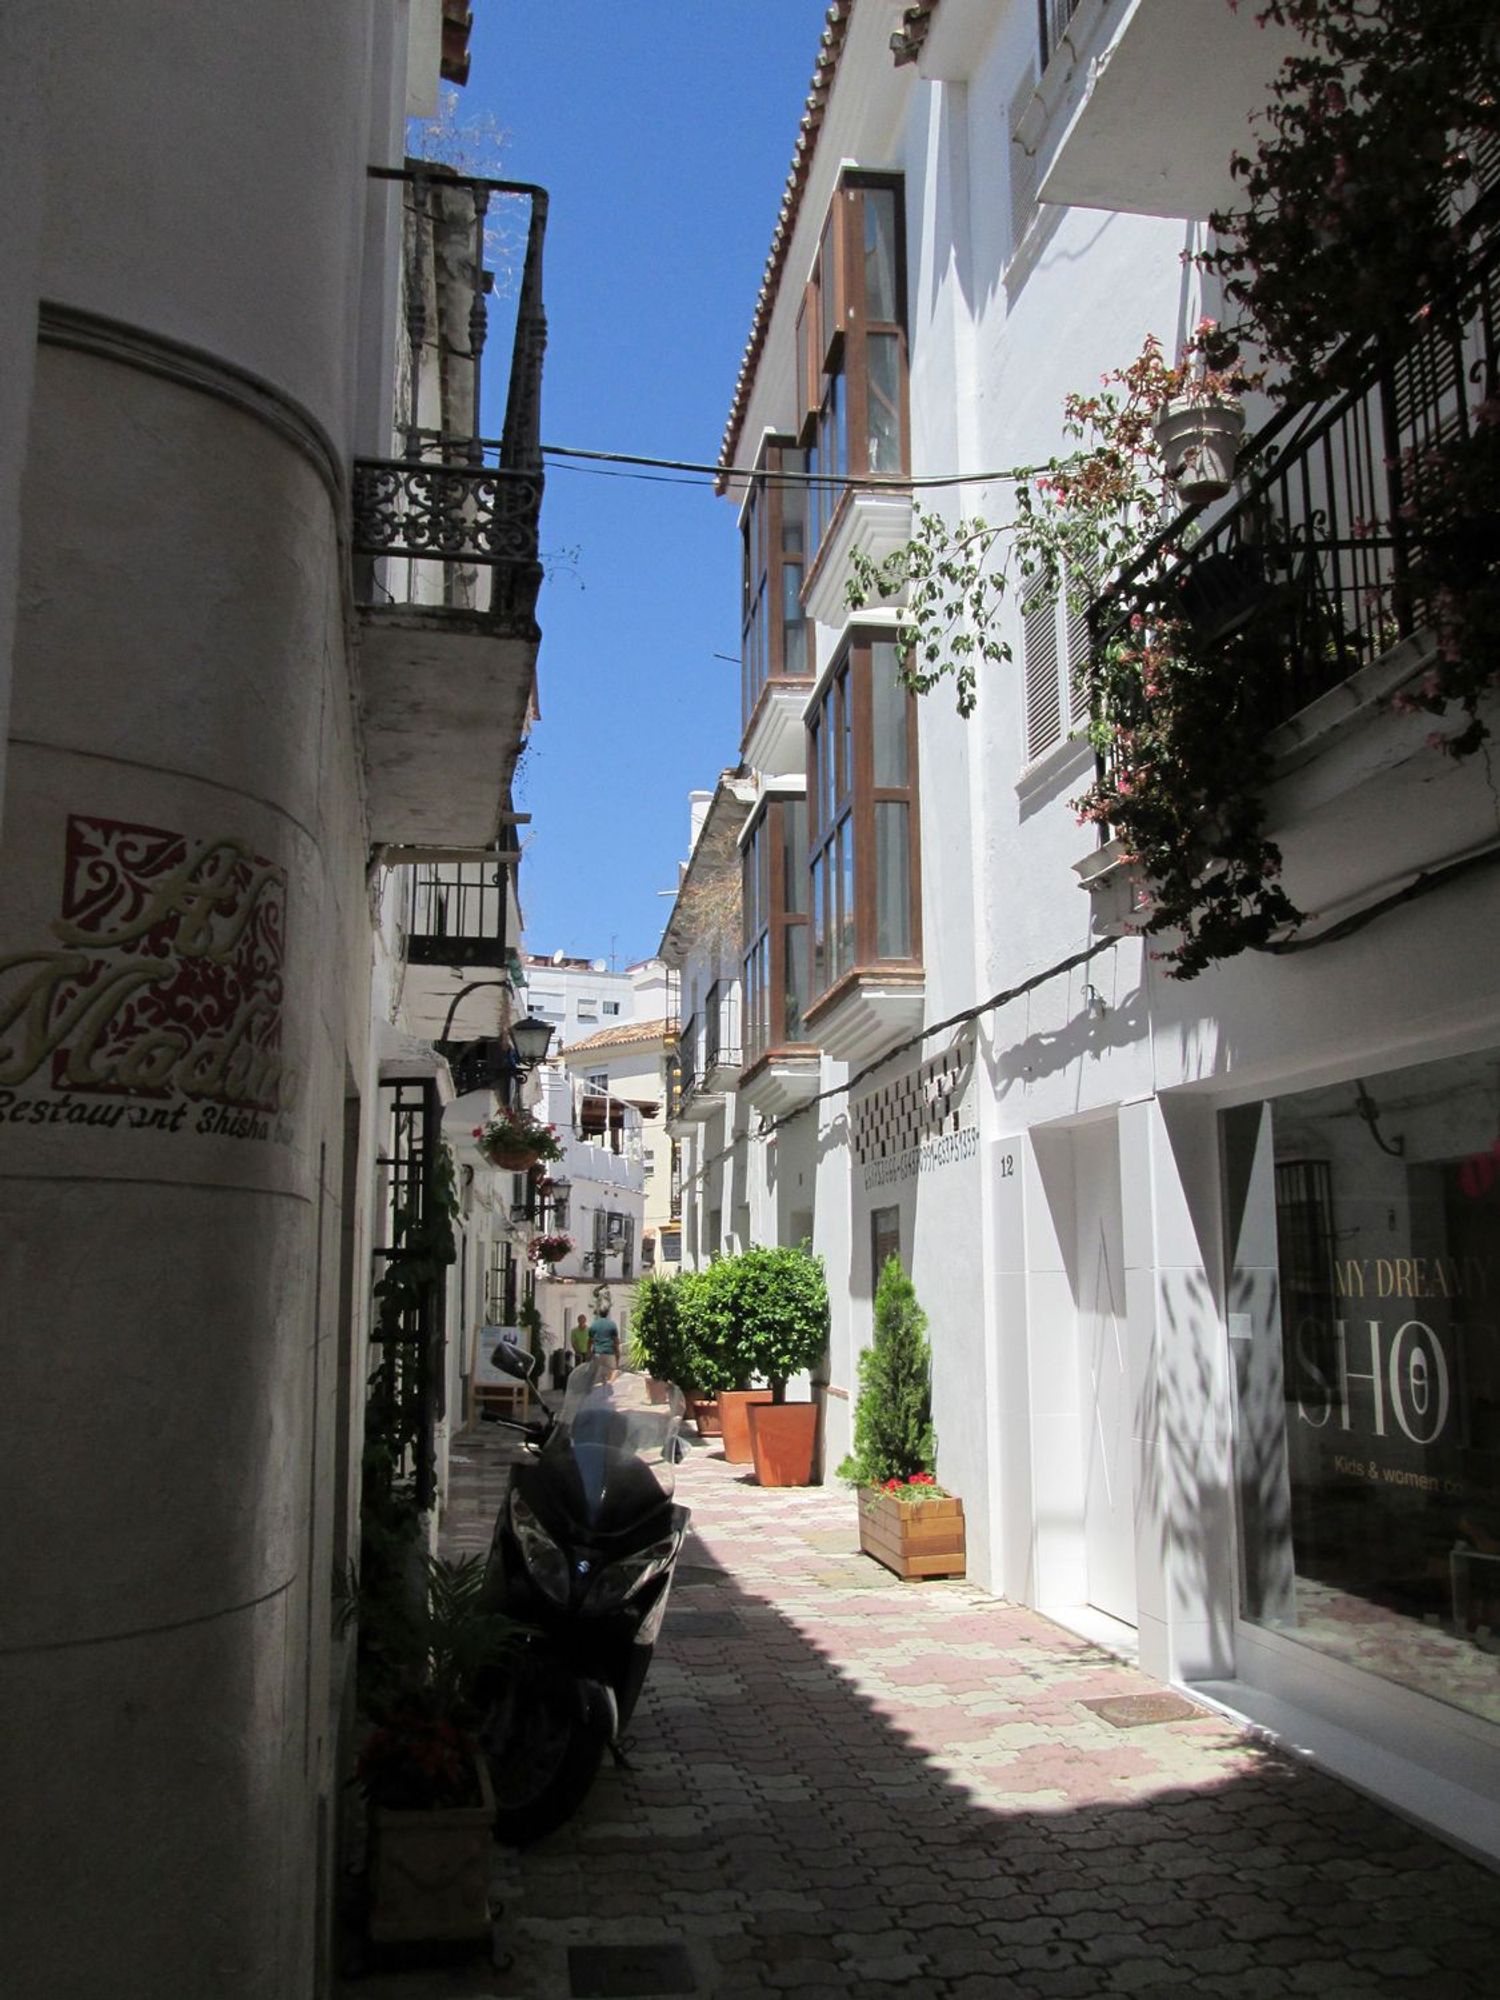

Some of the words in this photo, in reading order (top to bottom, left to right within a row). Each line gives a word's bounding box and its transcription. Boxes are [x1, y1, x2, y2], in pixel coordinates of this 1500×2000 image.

[196, 1104, 268, 1141] Shisha
[1001, 1154, 1014, 1178] 12
[1335, 1259, 1369, 1298] MY
[1297, 1316, 1495, 1450] SHO
[1335, 1455, 1365, 1477] Kids
[1367, 1461, 1379, 1480] &
[1382, 1467, 1440, 1492] women
